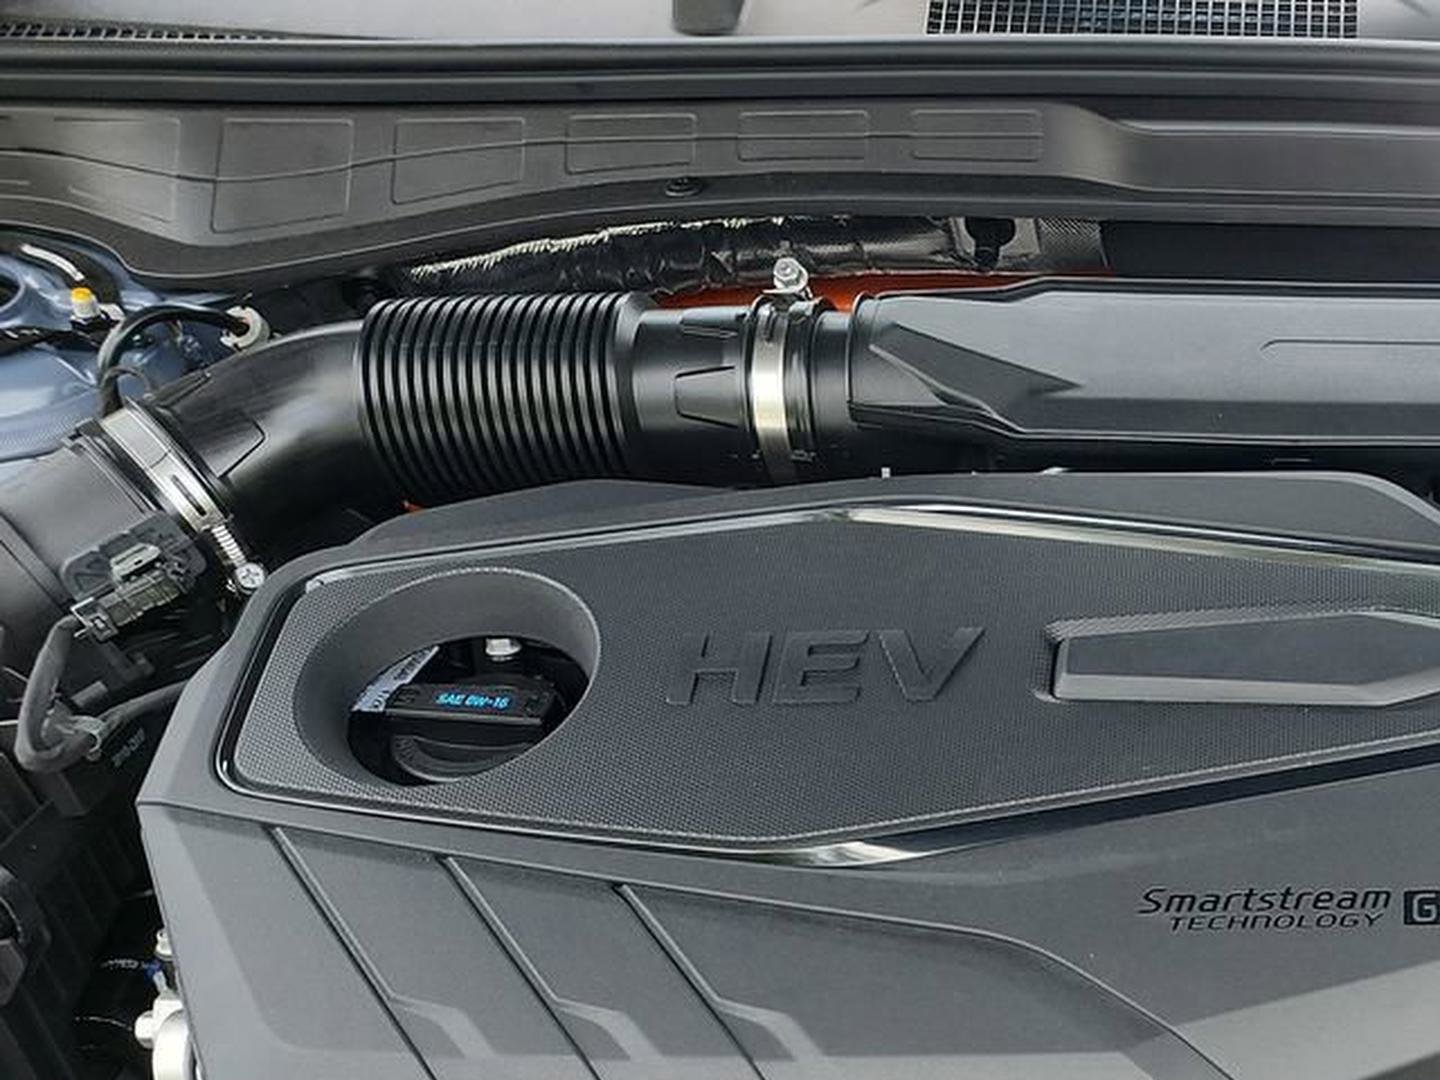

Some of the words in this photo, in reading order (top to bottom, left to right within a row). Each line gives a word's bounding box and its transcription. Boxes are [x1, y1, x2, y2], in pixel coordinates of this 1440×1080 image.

[666, 627, 986, 705] HEV
[435, 692, 464, 706] SAE
[1138, 886, 1393, 914] Smartstream
[1170, 912, 1385, 932] TECHNOLOGY
